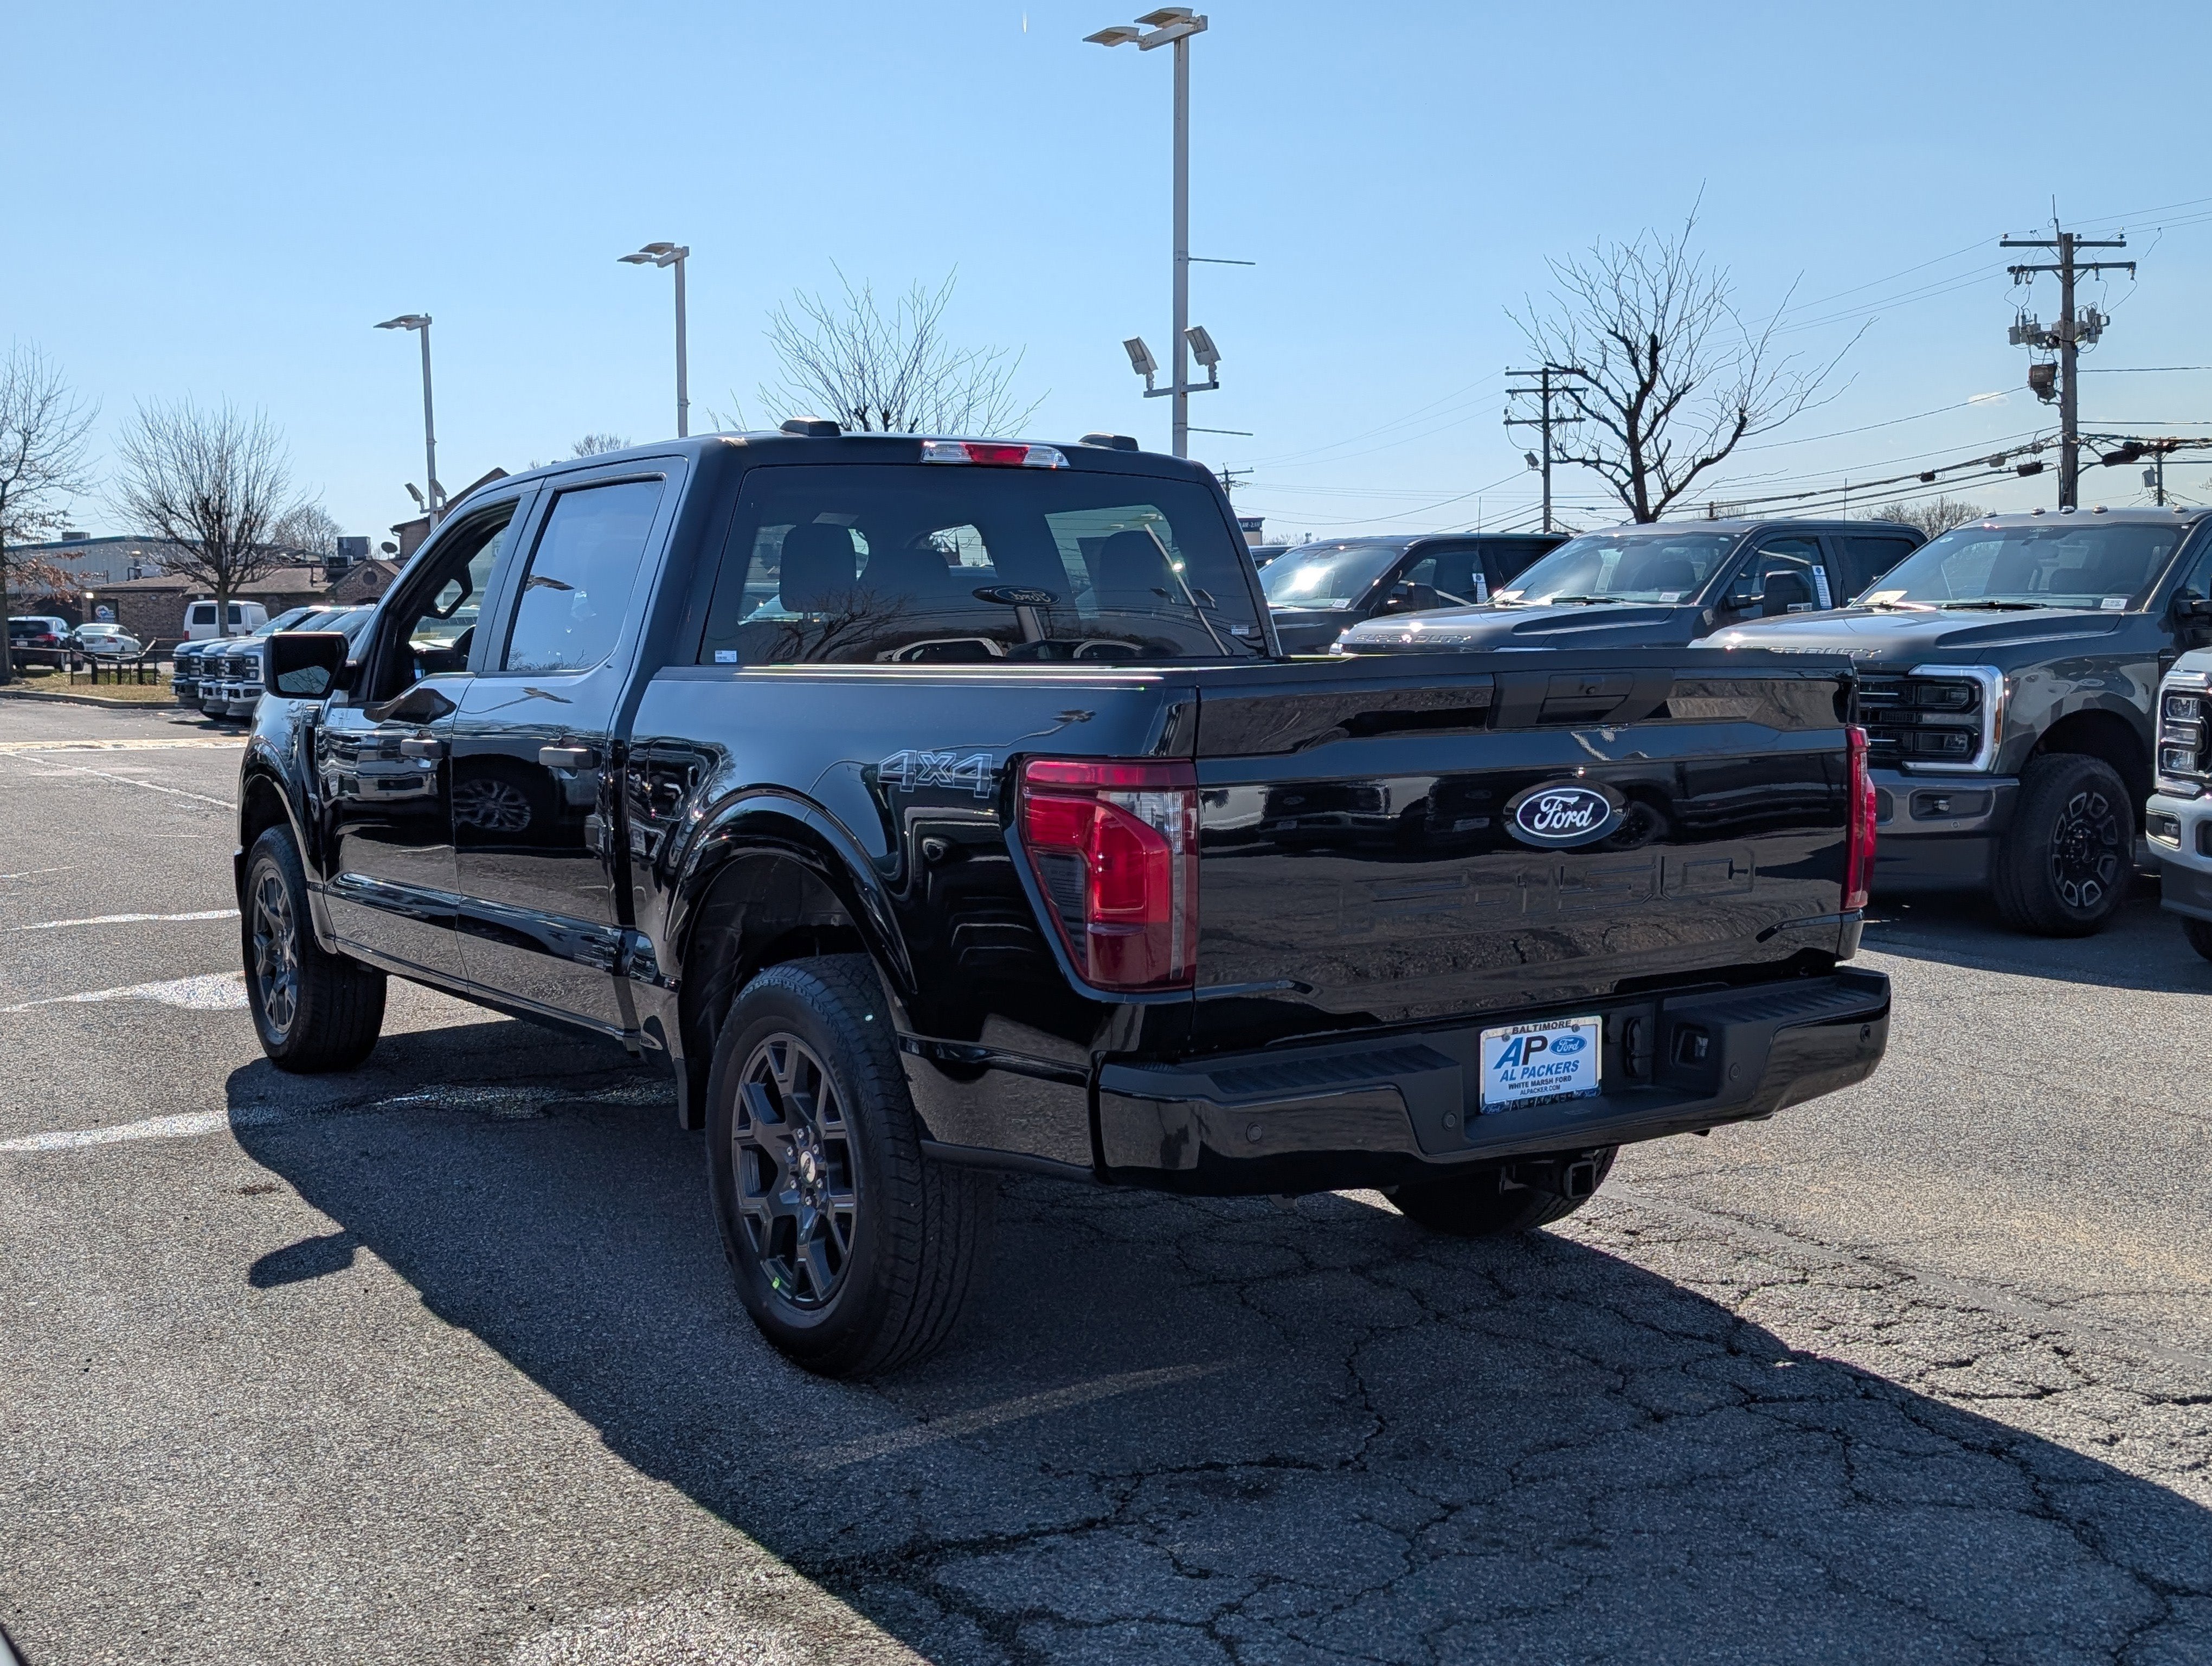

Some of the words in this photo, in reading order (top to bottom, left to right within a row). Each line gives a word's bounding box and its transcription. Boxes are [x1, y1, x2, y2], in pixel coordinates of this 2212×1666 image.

[1534, 796, 1594, 830] Ford
[1512, 1020, 1572, 1035] BALTIMORE
[1493, 1035, 1548, 1070] AP
[1499, 1069, 1516, 1082] AL
[1520, 1060, 1580, 1079] PACKERS
[1508, 1081, 1529, 1090] WHITE
[1531, 1078, 1553, 1086] MARSH
[1555, 1075, 1572, 1083] FORD
